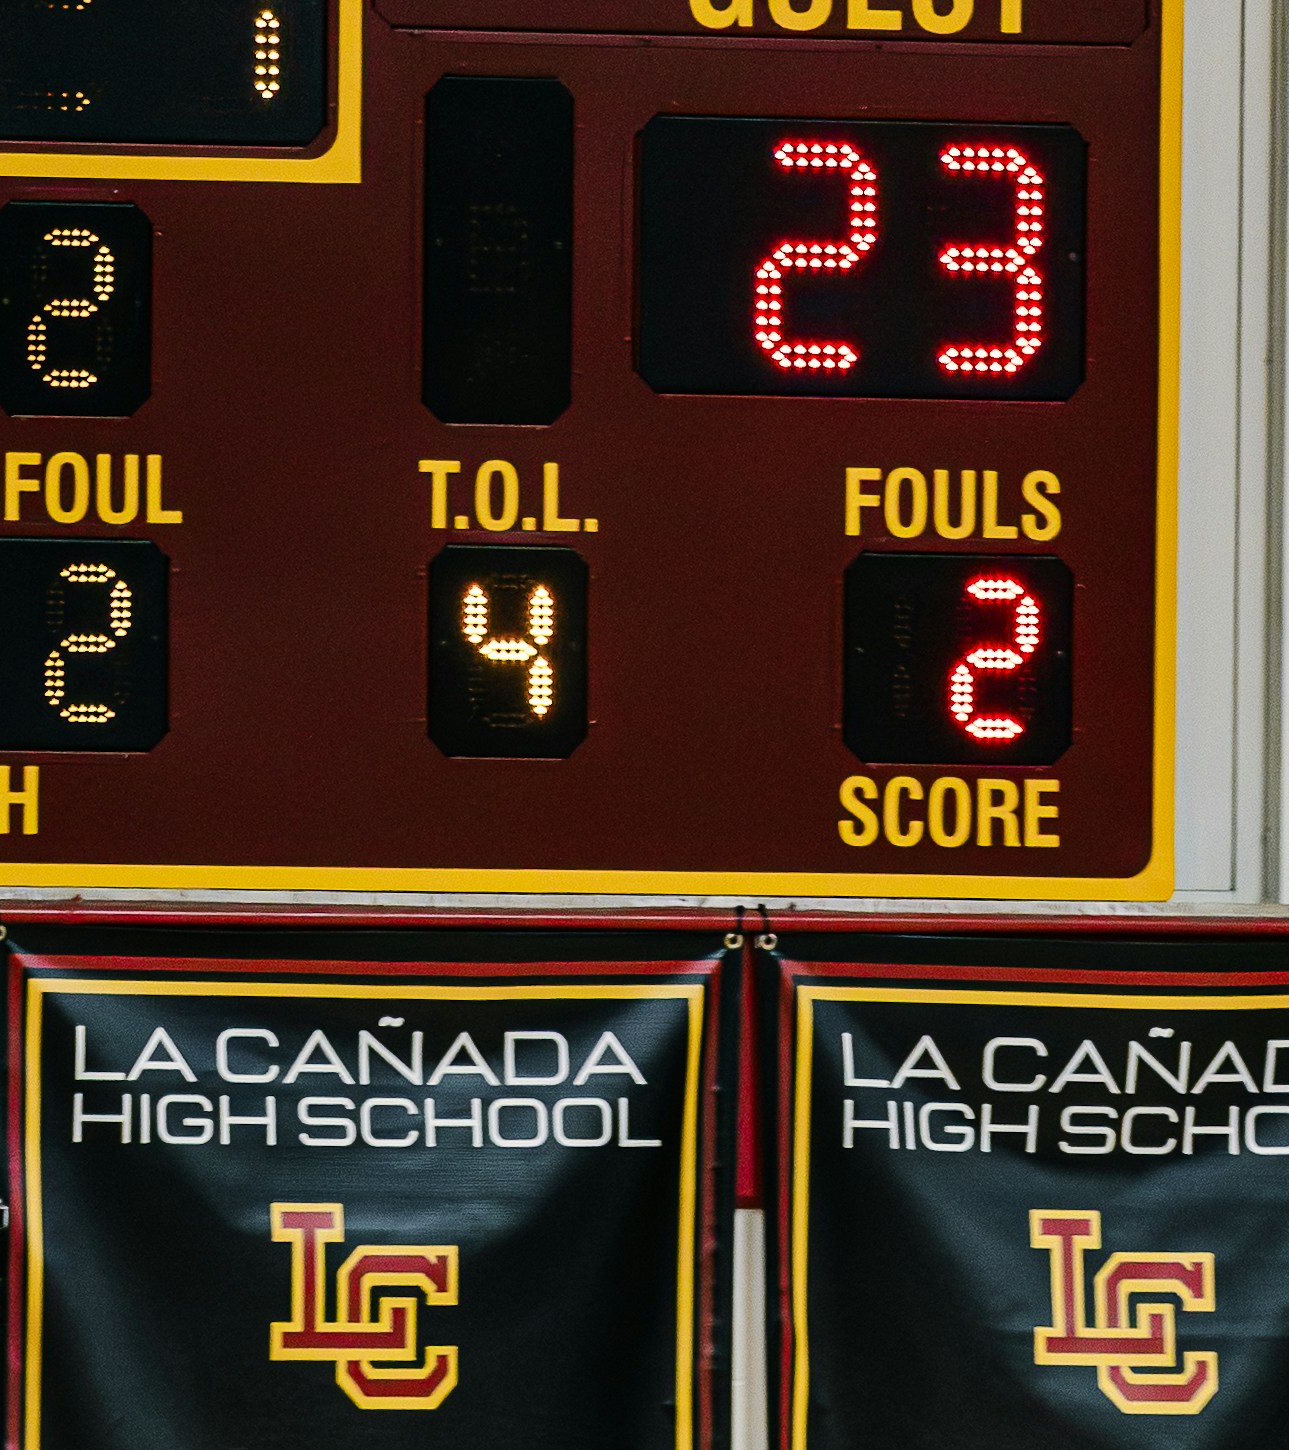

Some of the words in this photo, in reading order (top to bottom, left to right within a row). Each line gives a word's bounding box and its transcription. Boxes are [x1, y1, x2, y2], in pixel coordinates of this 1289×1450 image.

[752, 137, 1047, 379] 23
[26, 228, 115, 389] 2
[3, 451, 184, 525] FOUL
[418, 459, 599, 533] T.O.L.
[844, 466, 1062, 542] FOULS
[43, 562, 133, 723] 2
[461, 581, 556, 721] 4
[947, 572, 1044, 745] 2
[837, 775, 1061, 848] SCORE
[74, 1024, 198, 1083] LA
[215, 1015, 648, 1087] CAÑADA
[840, 1031, 961, 1091] LA
[72, 1092, 277, 1146] HIGH
[297, 1096, 662, 1148] SCHOOL
[842, 1098, 1040, 1154] HIGH
